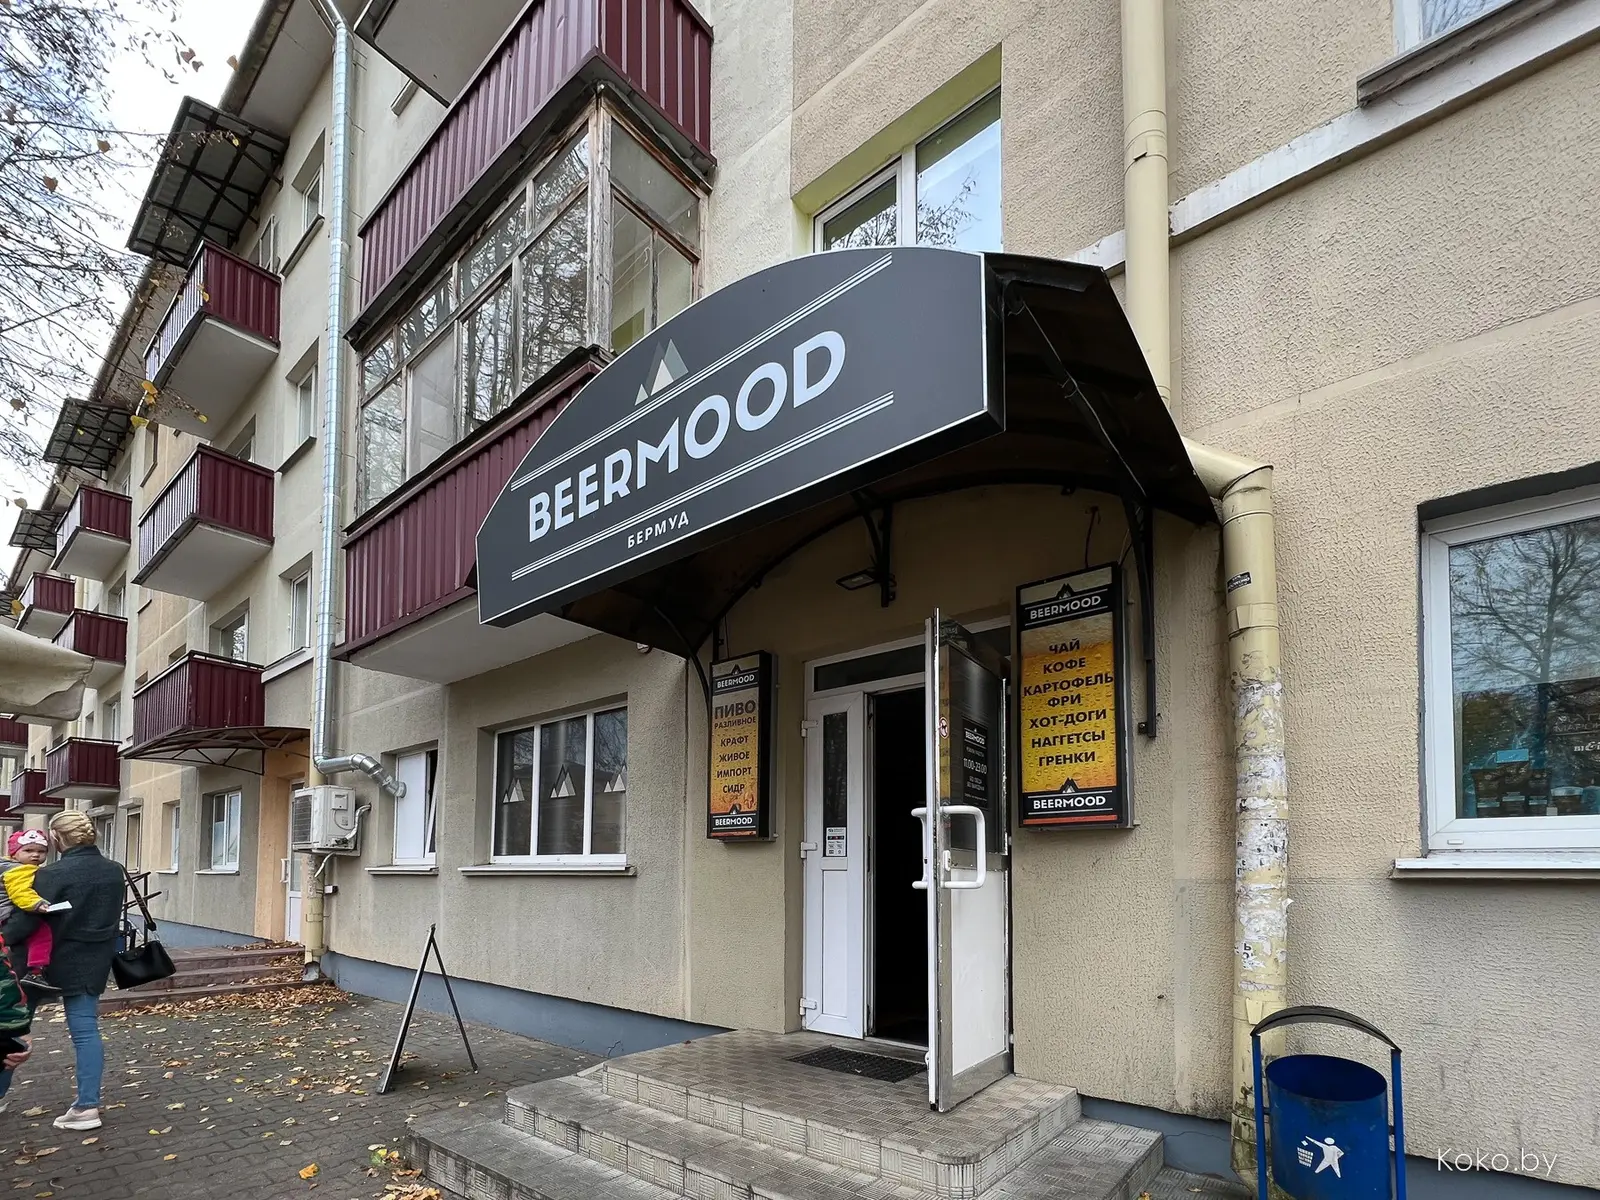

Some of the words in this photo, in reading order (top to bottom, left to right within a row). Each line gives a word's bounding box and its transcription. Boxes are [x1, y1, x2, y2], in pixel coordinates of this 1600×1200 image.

[529, 331, 846, 543] BEERMOOD
[627, 511, 690, 549] БЕРМУД
[1030, 595, 1101, 619] BEERMOOD
[1049, 638, 1080, 654] ЧАЙ
[1043, 657, 1086, 674] КОФЕ
[717, 674, 755, 688] BEERMOOD
[1023, 673, 1114, 696] КАРТОФЕЛЬ
[1047, 694, 1081, 707] ФРИ
[714, 700, 756, 719] ПИВО
[714, 716, 756, 729] РАЗЛИВНОЕ
[1029, 709, 1107, 729] ХОТ-ДОГИ
[721, 735, 749, 747] КРАФТ
[1031, 730, 1106, 748] НАГГЕТСЫ
[719, 751, 750, 763] ЖИВОЕ
[1038, 751, 1096, 767] ГРЕНКИ
[717, 767, 752, 778] ИМПОРТ
[722, 783, 745, 794] СИДР
[1033, 796, 1106, 809] BEERMOOD
[715, 817, 753, 826] BEERMOOD
